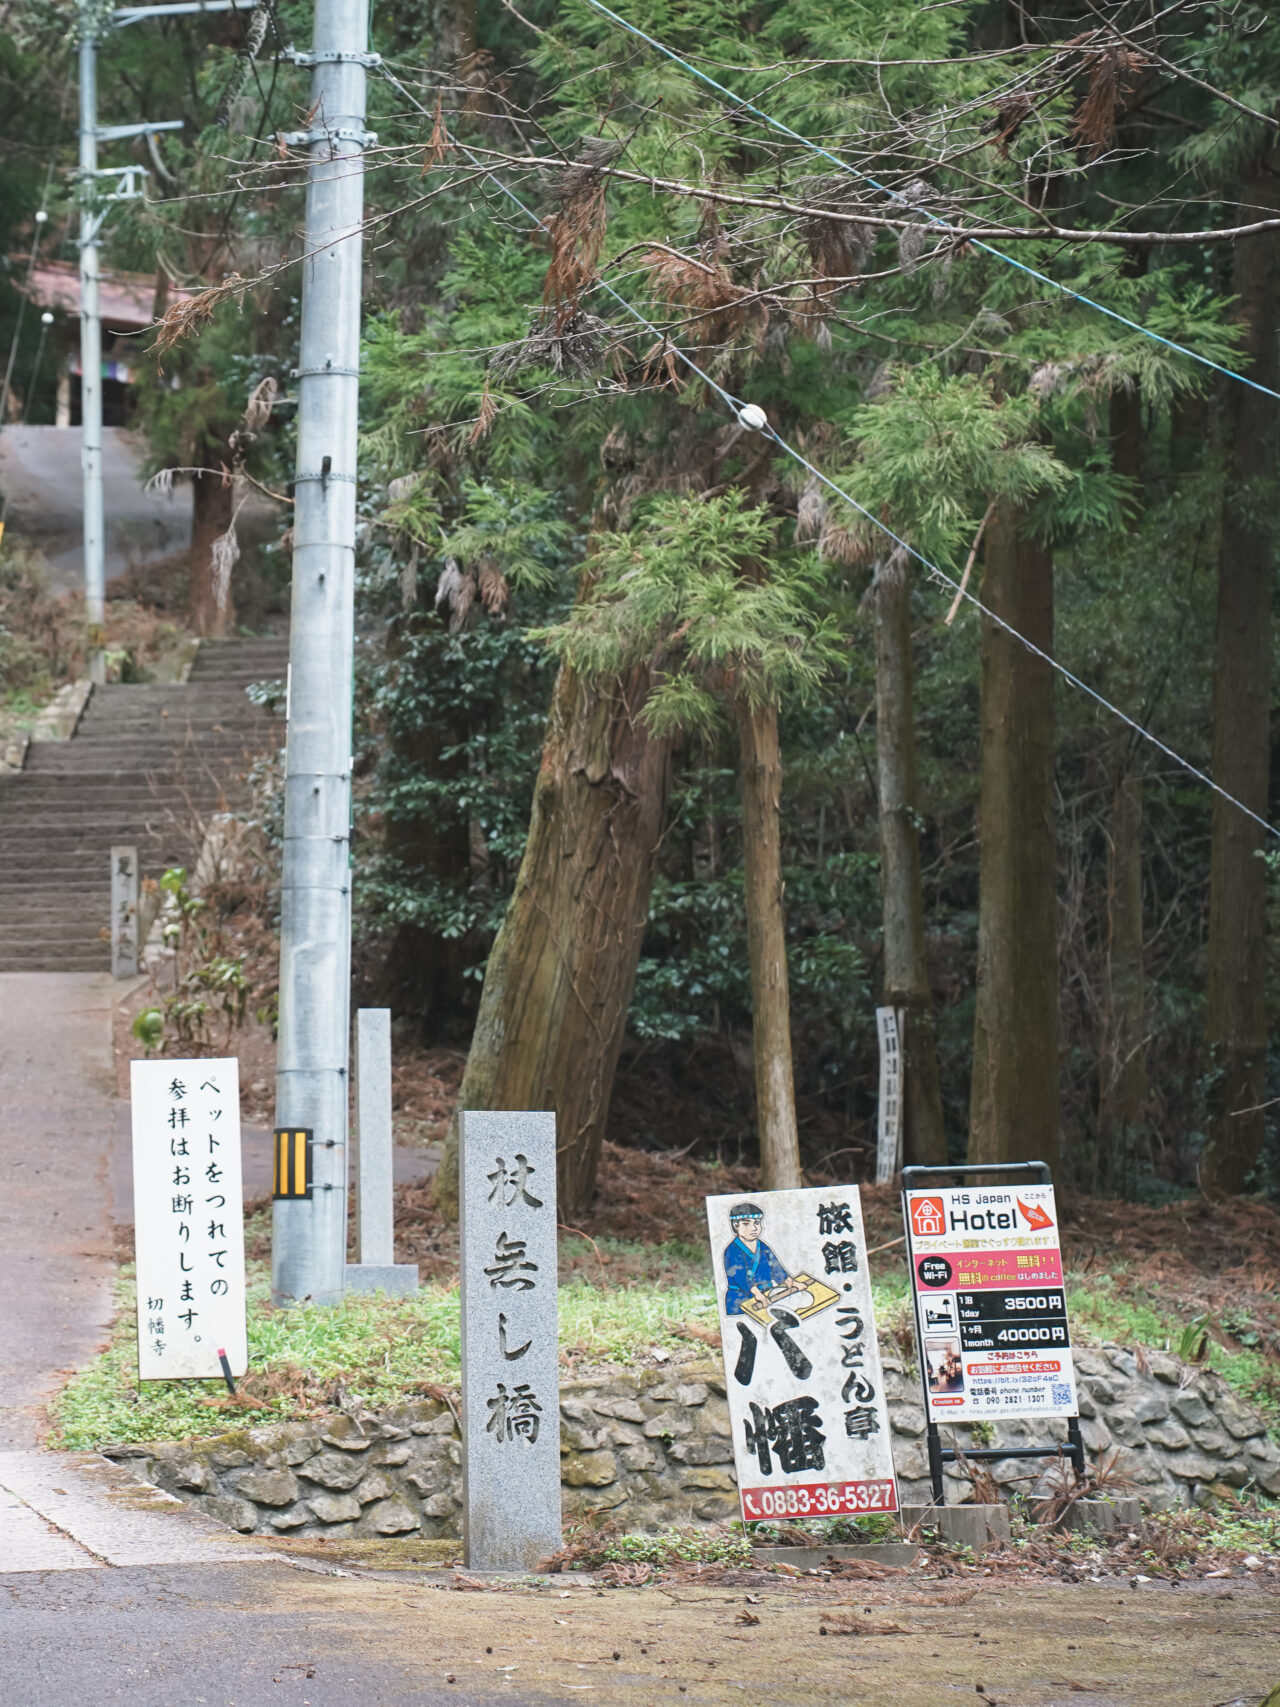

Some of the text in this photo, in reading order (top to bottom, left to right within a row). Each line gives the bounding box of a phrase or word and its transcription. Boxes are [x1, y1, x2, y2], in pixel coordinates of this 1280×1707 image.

[200, 1076, 229, 1297] ペットをつれての
[1024, 1192, 1047, 1200] ここから
[167, 1077, 201, 1343] 参拝はお断りします。
[951, 1194, 970, 1205] HS
[949, 1208, 1018, 1231] Hotel
[923, 1262, 946, 1270] Free
[957, 1258, 1008, 1268] インターネット
[923, 1271, 948, 1280] Wi-Fi
[483, 1153, 543, 1444] 杖無し橋
[147, 1296, 167, 1357] 切幡寺
[816, 1201, 880, 1441] 旅館・うどん亭
[987, 1350, 1039, 1361] ご予約はこちら
[734, 1307, 826, 1477] 八幡
[1000, 1387, 1020, 1396] phone
[1021, 1386, 1046, 1394] number
[761, 1483, 892, 1515] 0883-36-5327
